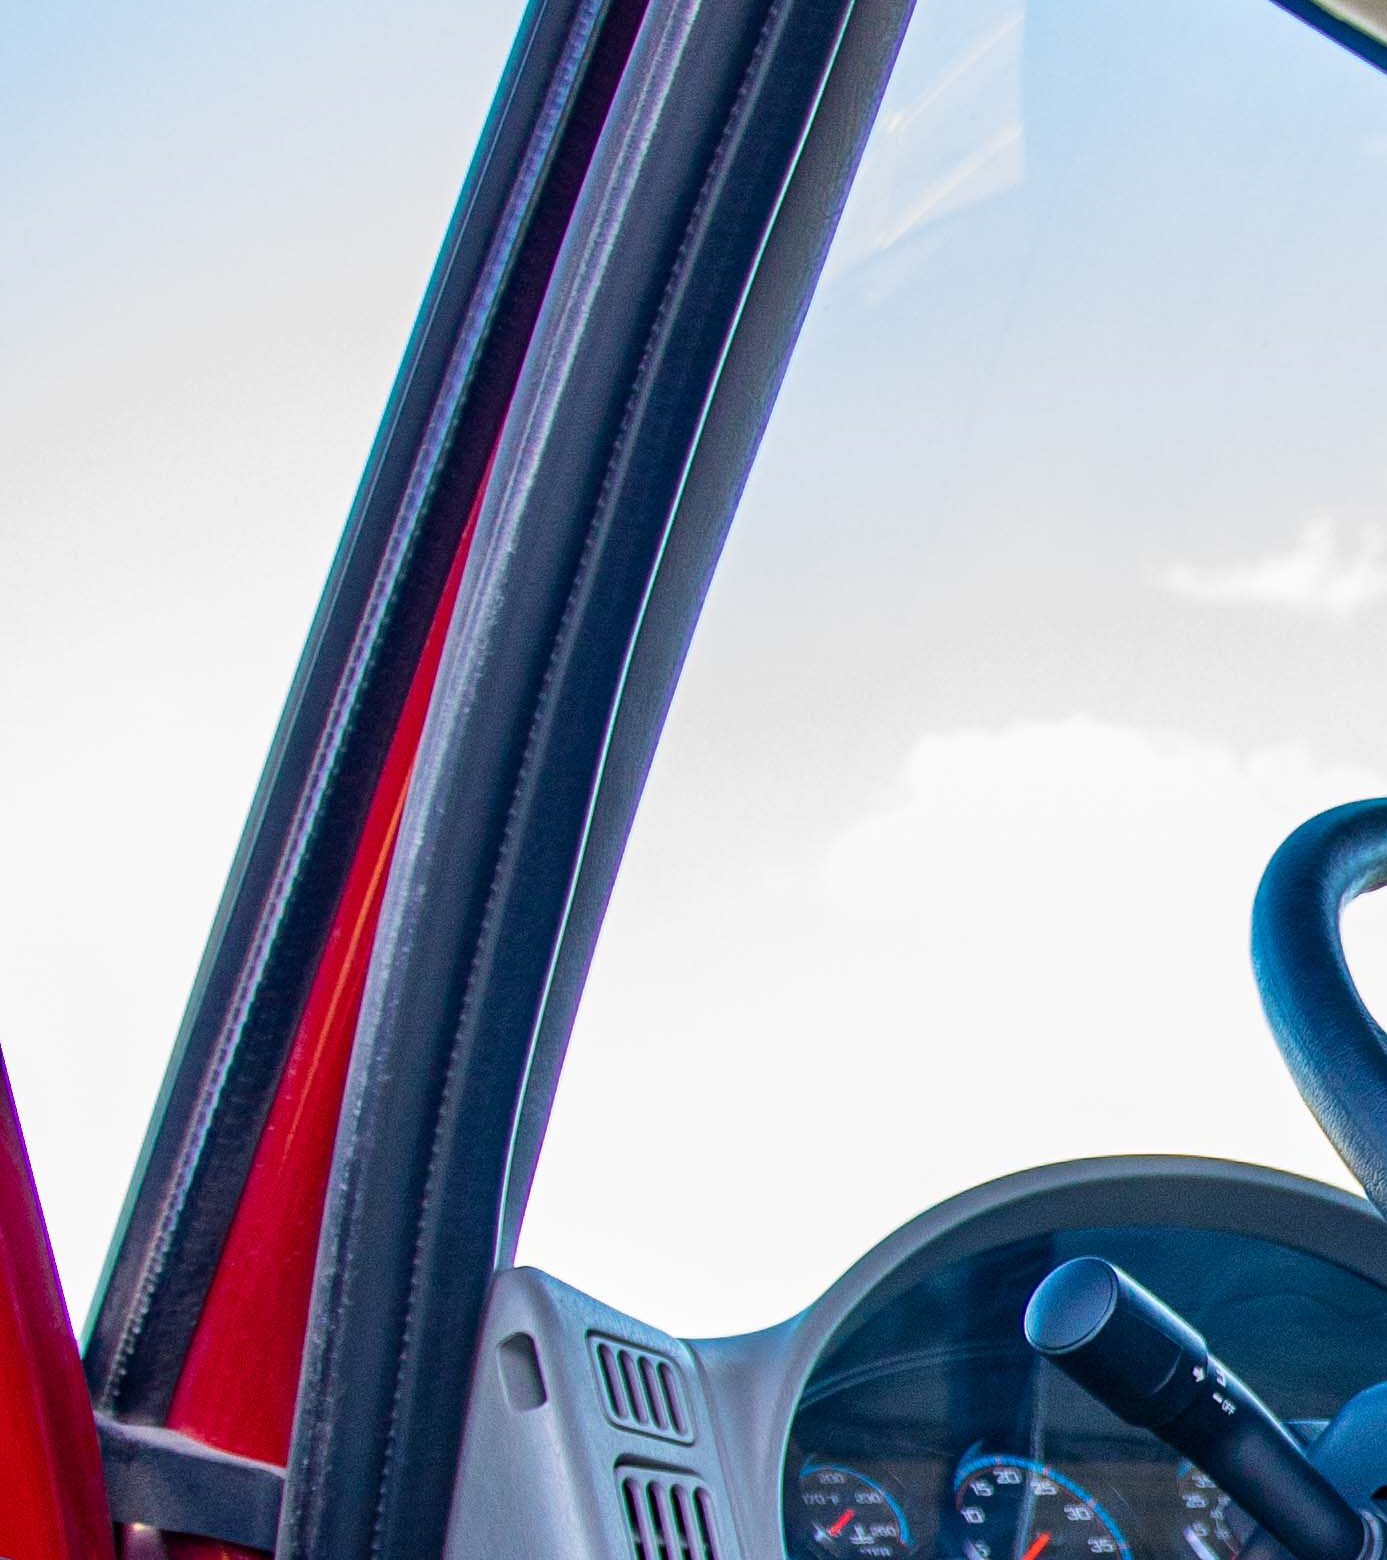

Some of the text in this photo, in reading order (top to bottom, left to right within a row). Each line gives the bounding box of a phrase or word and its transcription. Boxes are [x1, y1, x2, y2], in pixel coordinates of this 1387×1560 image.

[1221, 1399, 1236, 1415] OFF
[971, 1479, 994, 1497] 15
[961, 1507, 985, 1524] 10
[1064, 1504, 1093, 1521] 30
[1088, 1536, 1115, 1553] 35
